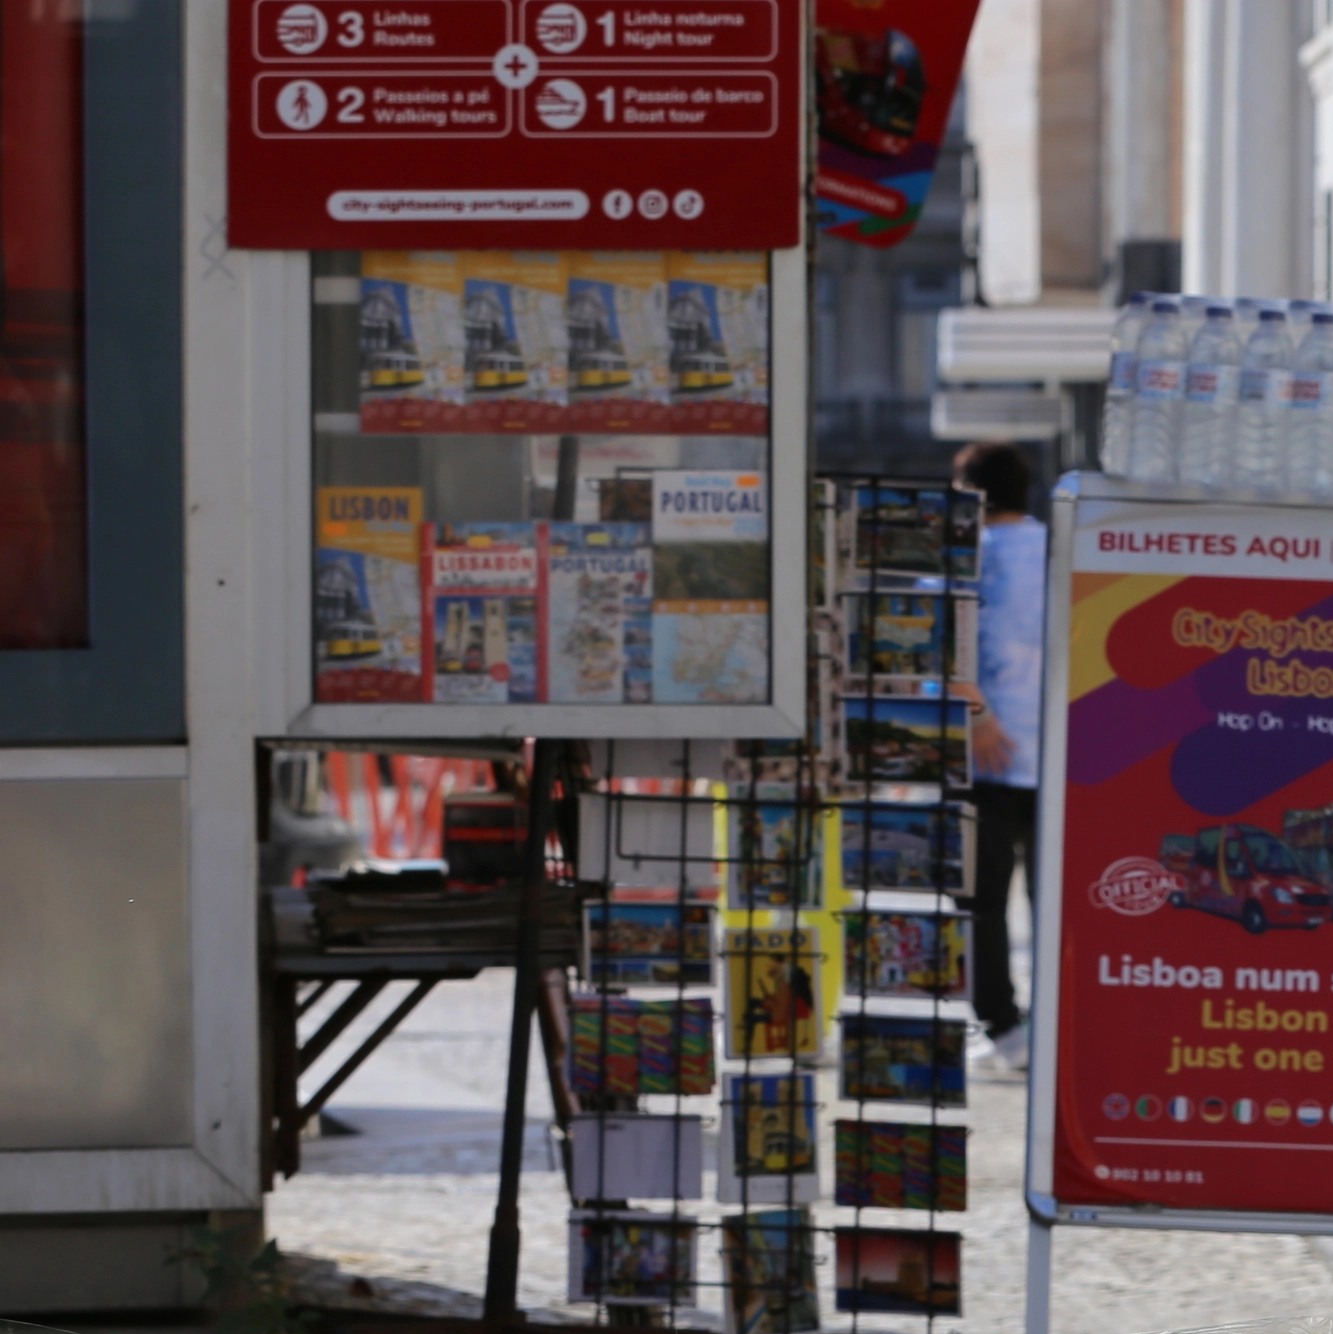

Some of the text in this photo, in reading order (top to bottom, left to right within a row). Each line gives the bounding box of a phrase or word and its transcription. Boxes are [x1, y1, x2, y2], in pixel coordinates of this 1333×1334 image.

[337, 11, 365, 47] 3
[373, 11, 431, 26] Linhas
[596, 10, 615, 47] 1
[624, 11, 744, 26] Linha noturna
[373, 30, 434, 46] Routes
[624, 31, 713, 49] Night tour
[337, 87, 365, 123] 2
[373, 87, 489, 106] Passeios a pé
[596, 86, 615, 123] 1
[624, 87, 764, 103] Passeio de barco
[373, 108, 497, 126] Walking tours
[624, 108, 706, 123] Boat tour
[329, 496, 409, 520] LISBON
[661, 491, 762, 513] PORTUGAL
[1098, 531, 1236, 556] BILHETES
[1246, 536, 1320, 561] AQUI
[439, 556, 533, 571] LISSABON
[551, 557, 648, 573] PORTUGAL
[1217, 711, 1253, 732] Hop
[1257, 711, 1284, 731] On
[1098, 955, 1223, 988] Lisboa
[1235, 968, 1319, 992] num
[1201, 999, 1328, 1032] Lisbon
[1166, 1036, 1243, 1074] just
[1254, 1047, 1324, 1071] one
